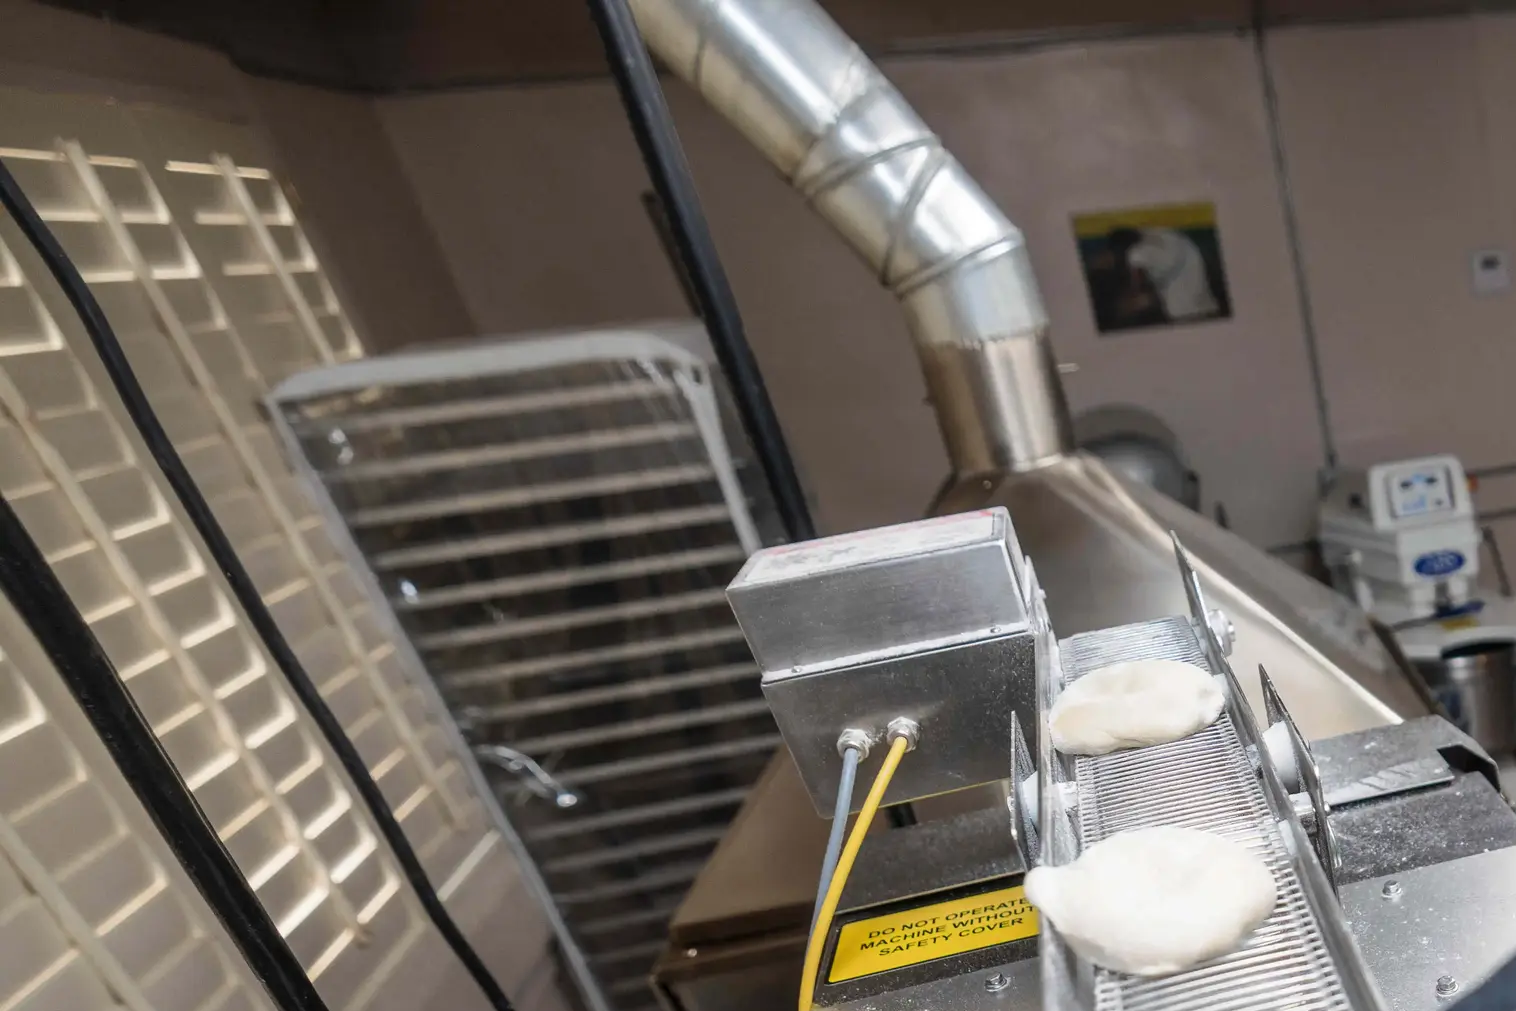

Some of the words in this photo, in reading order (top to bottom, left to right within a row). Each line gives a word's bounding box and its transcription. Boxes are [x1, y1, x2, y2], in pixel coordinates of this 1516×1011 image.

[859, 924, 946, 951] MACHINE
[952, 905, 1034, 929] WITHOUT
[868, 927, 896, 939] DO
[901, 916, 941, 932] NOT
[945, 897, 1031, 921] OPERATE
[878, 934, 951, 957] SAFETY
[958, 916, 1024, 938] COVER
